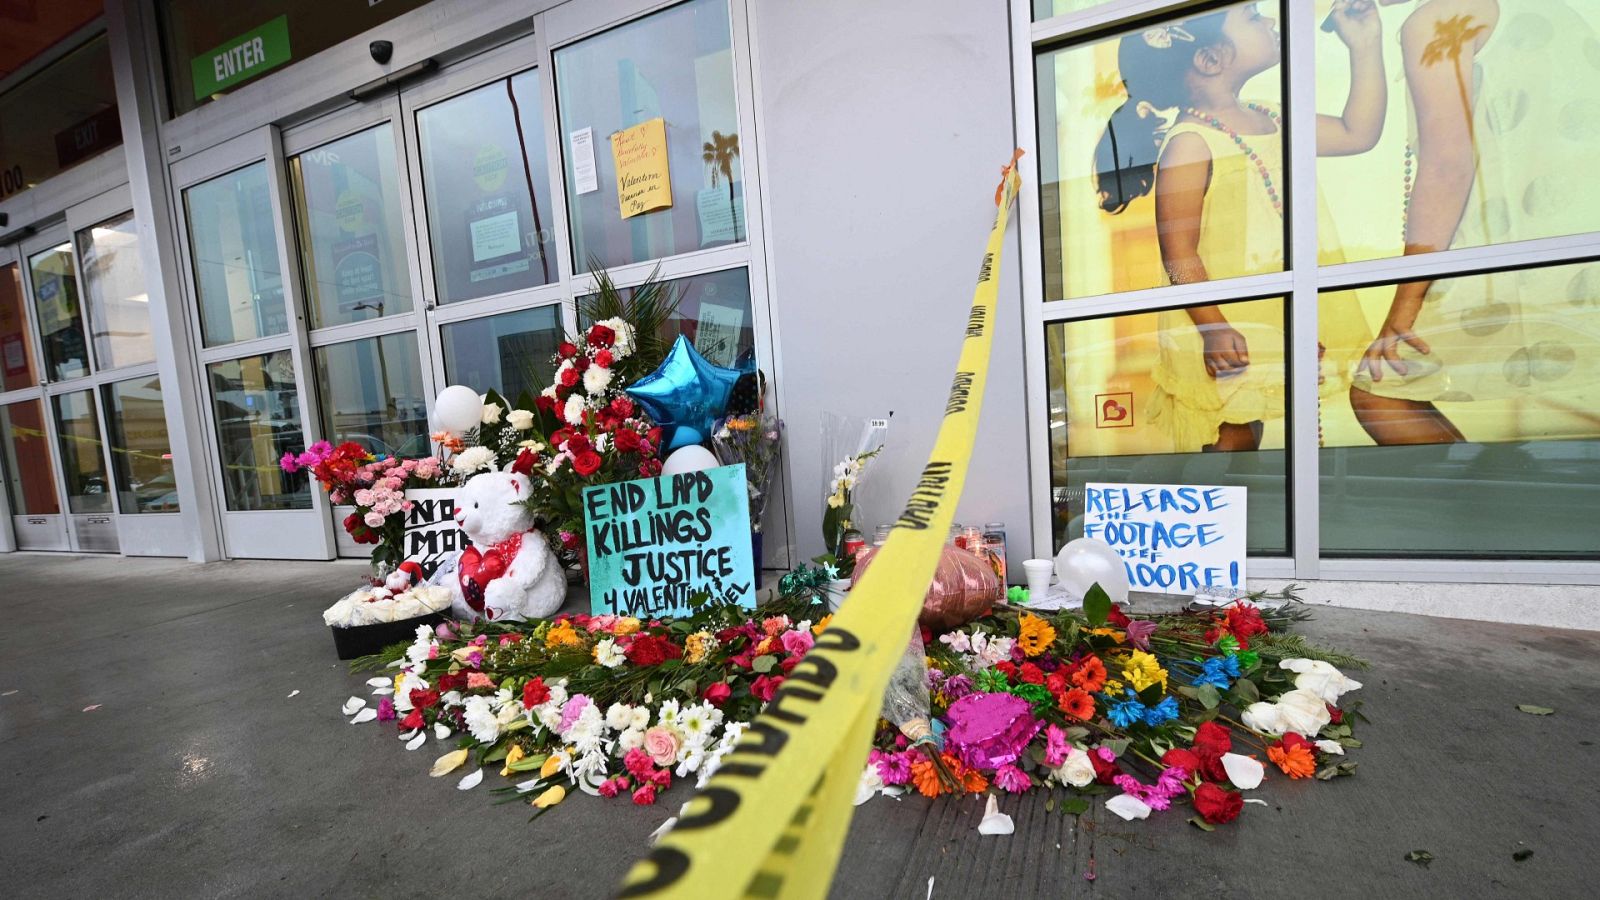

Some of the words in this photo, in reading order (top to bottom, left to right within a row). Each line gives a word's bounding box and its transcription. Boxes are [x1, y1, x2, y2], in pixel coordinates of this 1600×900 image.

[214, 36, 265, 81] ENTER
[74, 119, 98, 150] EXIT
[587, 482, 646, 520] END
[654, 471, 714, 509] LAPD
[1086, 487, 1230, 513] RELEASE
[410, 498, 455, 524] NO
[1095, 512, 1133, 521] THE
[1084, 520, 1224, 550] FOOTAGE
[604, 588, 617, 615] 4
